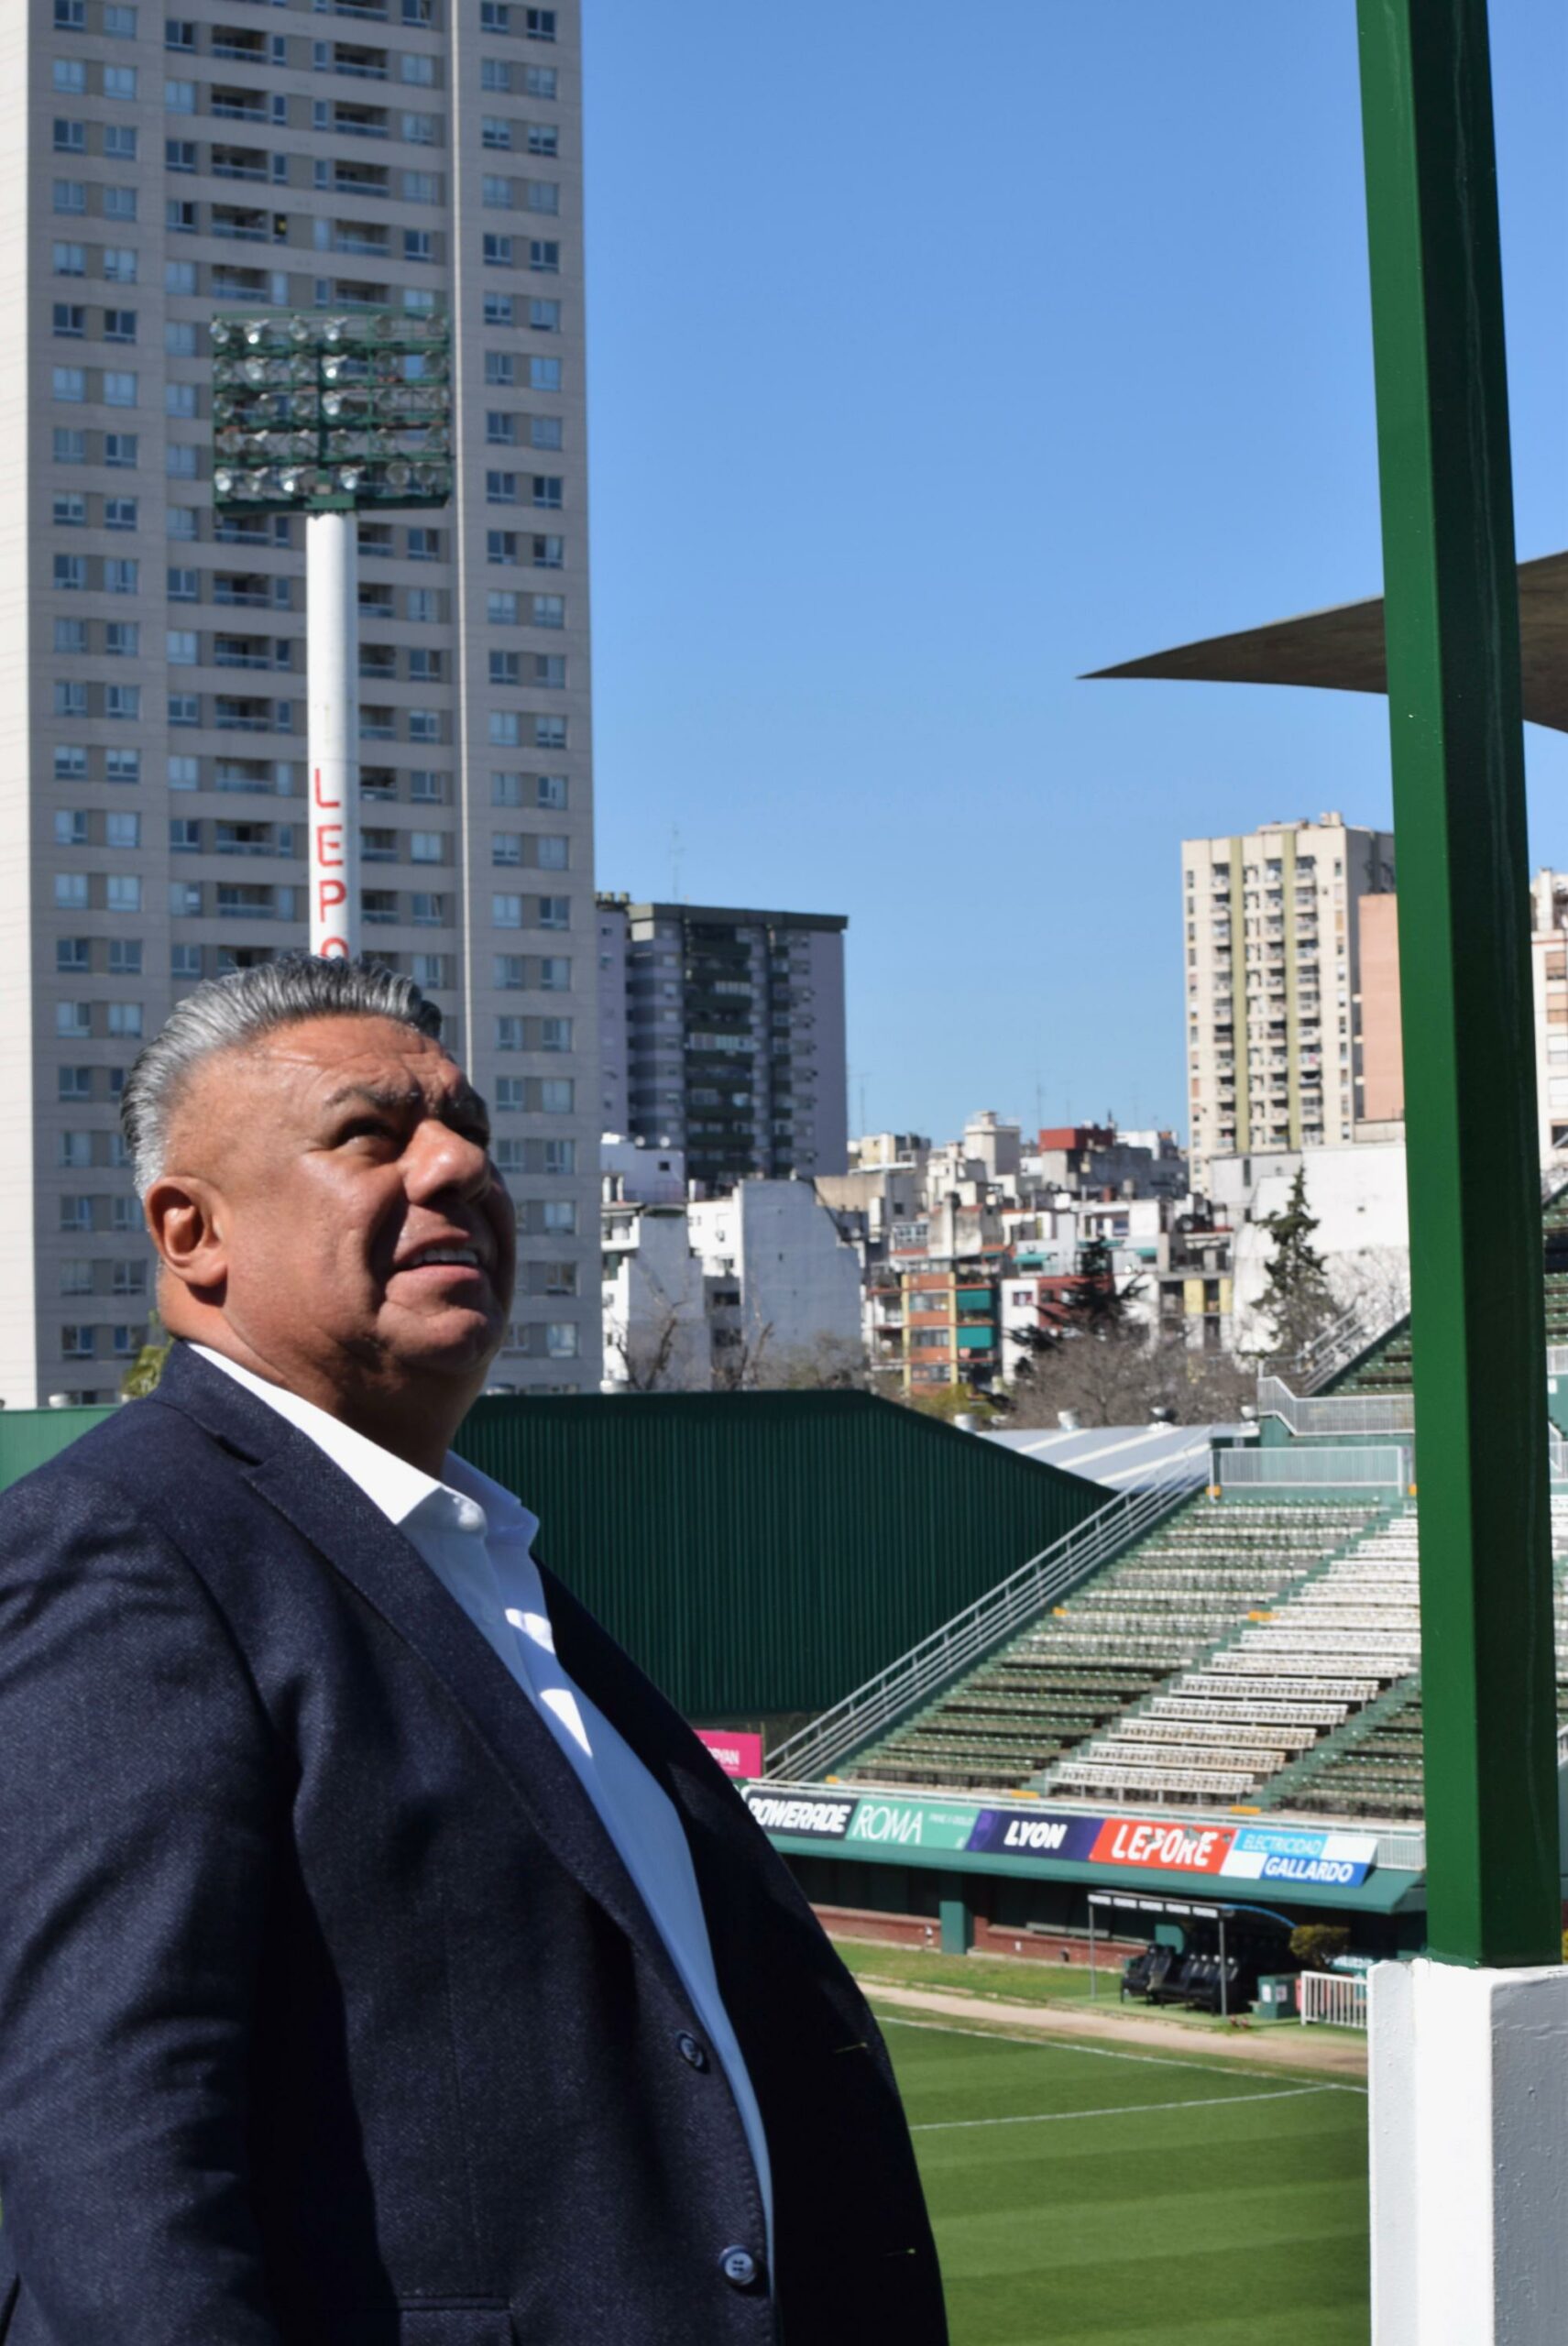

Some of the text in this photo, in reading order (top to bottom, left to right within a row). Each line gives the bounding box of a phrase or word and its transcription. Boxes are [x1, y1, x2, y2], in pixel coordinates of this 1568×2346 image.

[852, 1804, 923, 1845] ROMA
[1003, 1820, 1067, 1849] LYON
[1243, 1834, 1321, 1854] ELECTRICIDAD
[1265, 1857, 1354, 1883] GALLARDO
